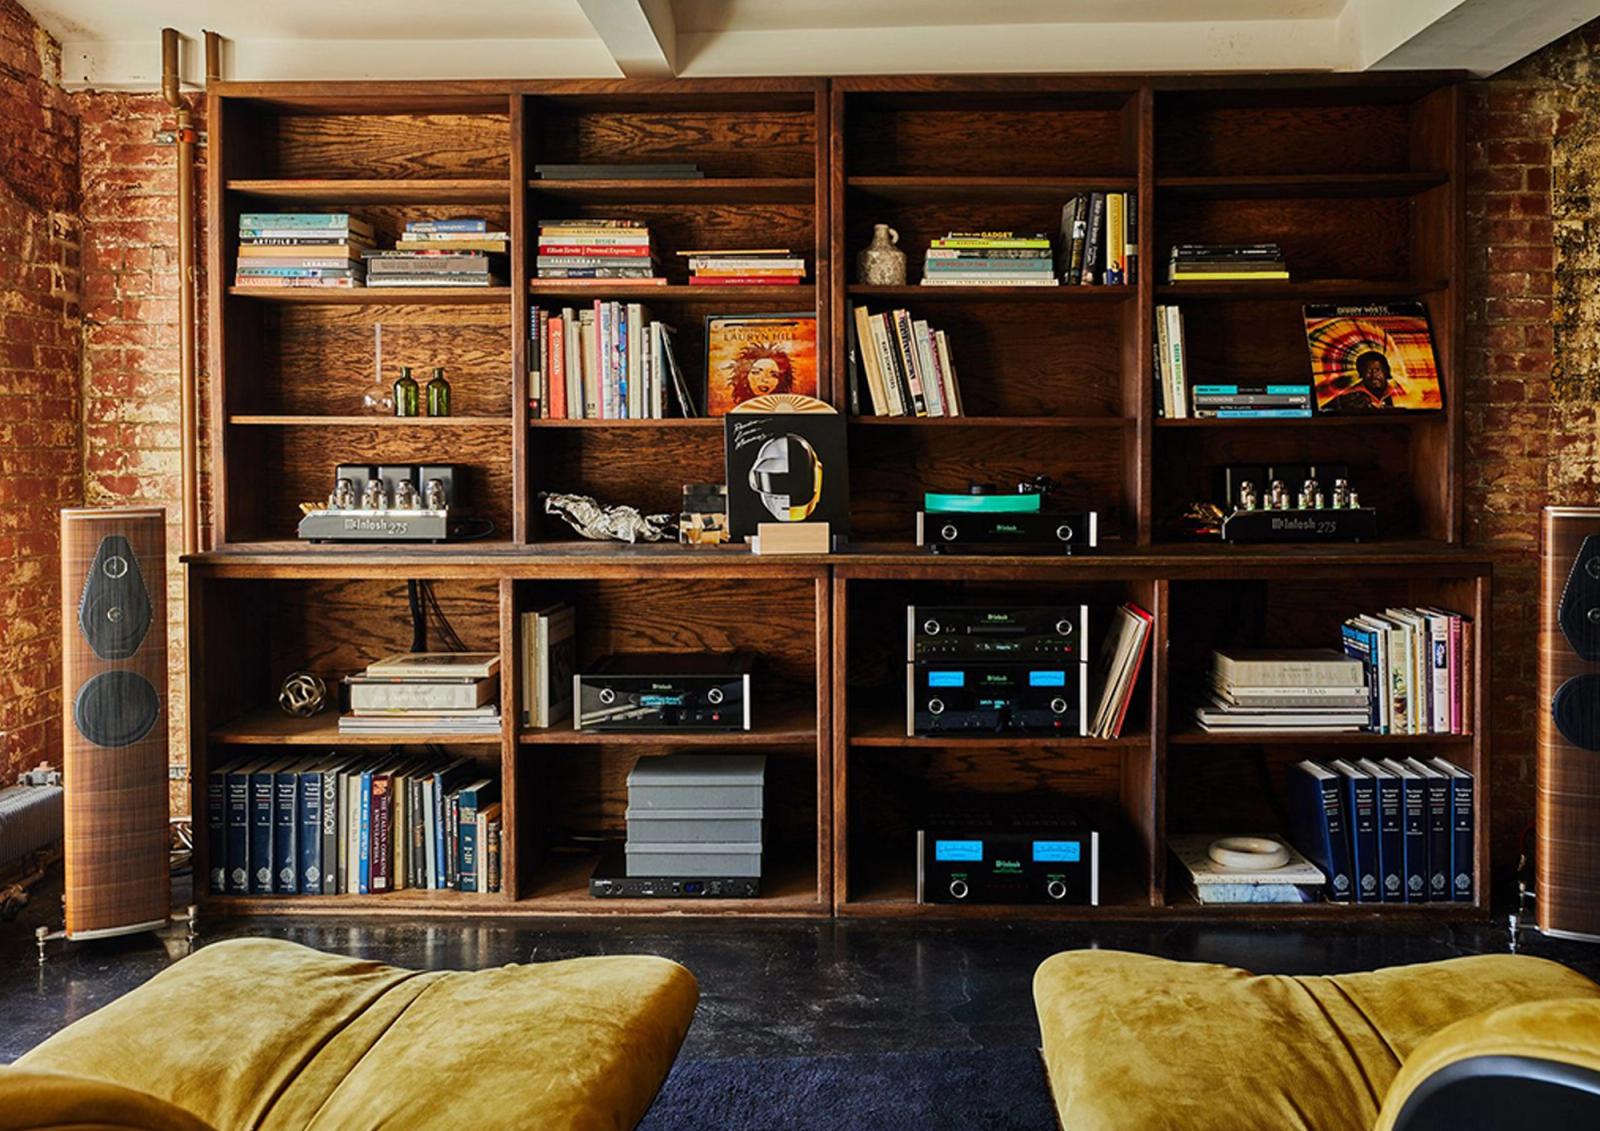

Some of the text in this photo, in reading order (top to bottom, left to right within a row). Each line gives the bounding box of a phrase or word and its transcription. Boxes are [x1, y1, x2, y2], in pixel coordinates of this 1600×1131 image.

[724, 333, 769, 341] LAURYN
[881, 341, 889, 356] KURT
[388, 521, 408, 534] 275
[1316, 521, 1337, 534] 275
[324, 772, 335, 835] ROYAL OAK
